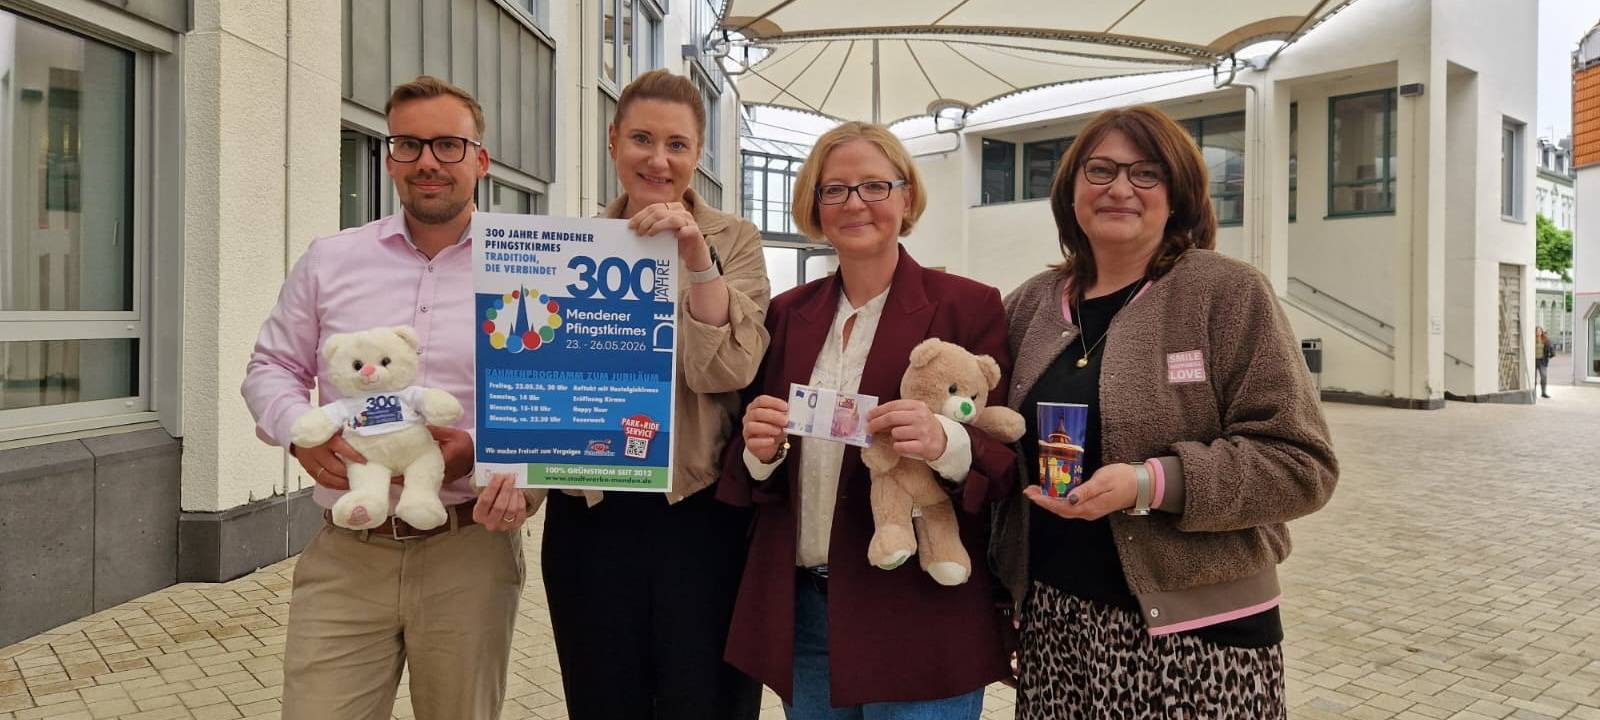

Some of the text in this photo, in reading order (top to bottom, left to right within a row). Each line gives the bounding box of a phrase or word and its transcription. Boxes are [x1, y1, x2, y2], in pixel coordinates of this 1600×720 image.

[485, 228, 594, 243] 300 JAHRE MENDENER
[485, 240, 561, 252] PFINGSTKIRMES
[485, 252, 540, 264] TRADITION,
[485, 264, 557, 275] DIE VERBINDET
[566, 255, 656, 300] 300
[566, 309, 631, 321] Mendener
[566, 323, 647, 336] Pfingstkirmes
[566, 340, 581, 349] 23.
[590, 341, 646, 351] 26.05.2026
[1168, 352, 1201, 362] SMILE
[1169, 369, 1202, 380] LOVE
[366, 395, 396, 410] 300
[626, 426, 653, 437] SERVICE
[545, 466, 565, 474] 100%
[567, 467, 616, 476] GRÜNSTROM
